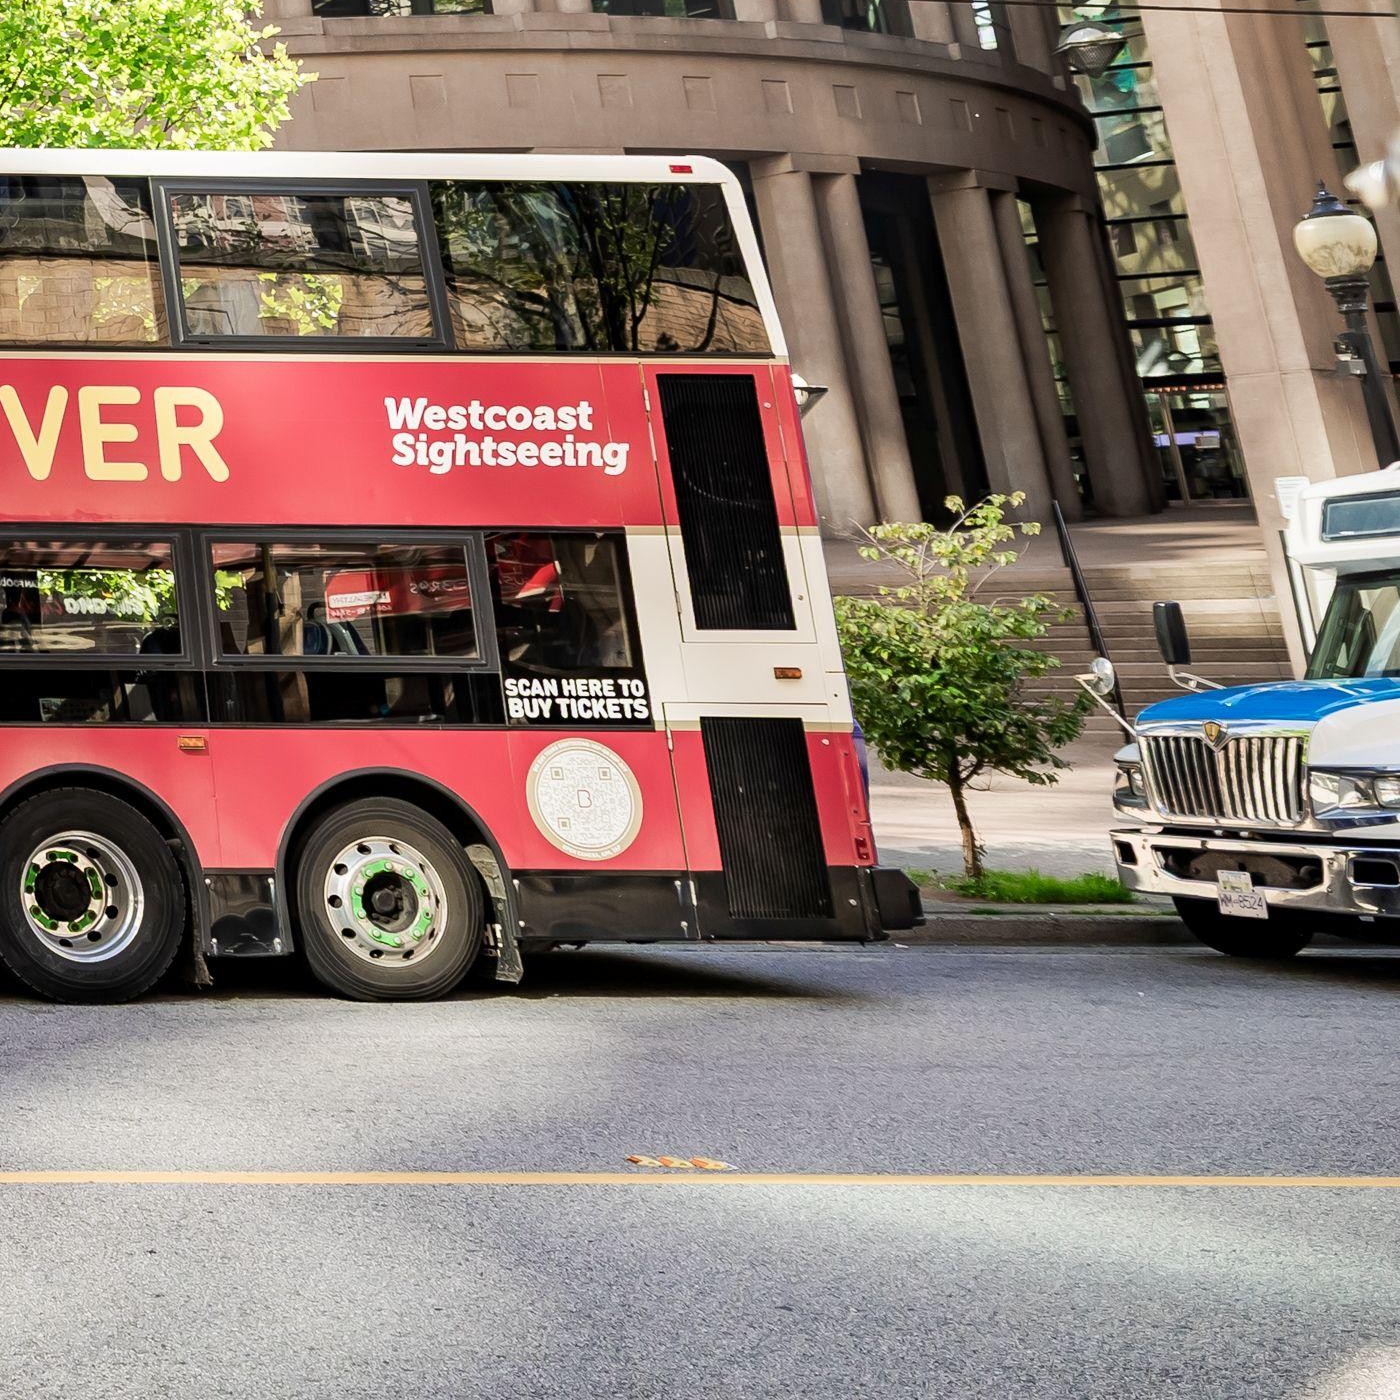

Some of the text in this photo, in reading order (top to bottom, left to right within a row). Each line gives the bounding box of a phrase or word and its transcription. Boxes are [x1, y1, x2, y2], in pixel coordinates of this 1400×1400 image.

[384, 397, 593, 431] Westcoast
[392, 432, 630, 475] Sightseeing
[504, 678, 645, 697] SCAN HERE TO
[508, 698, 649, 719] BUY TICKETS
